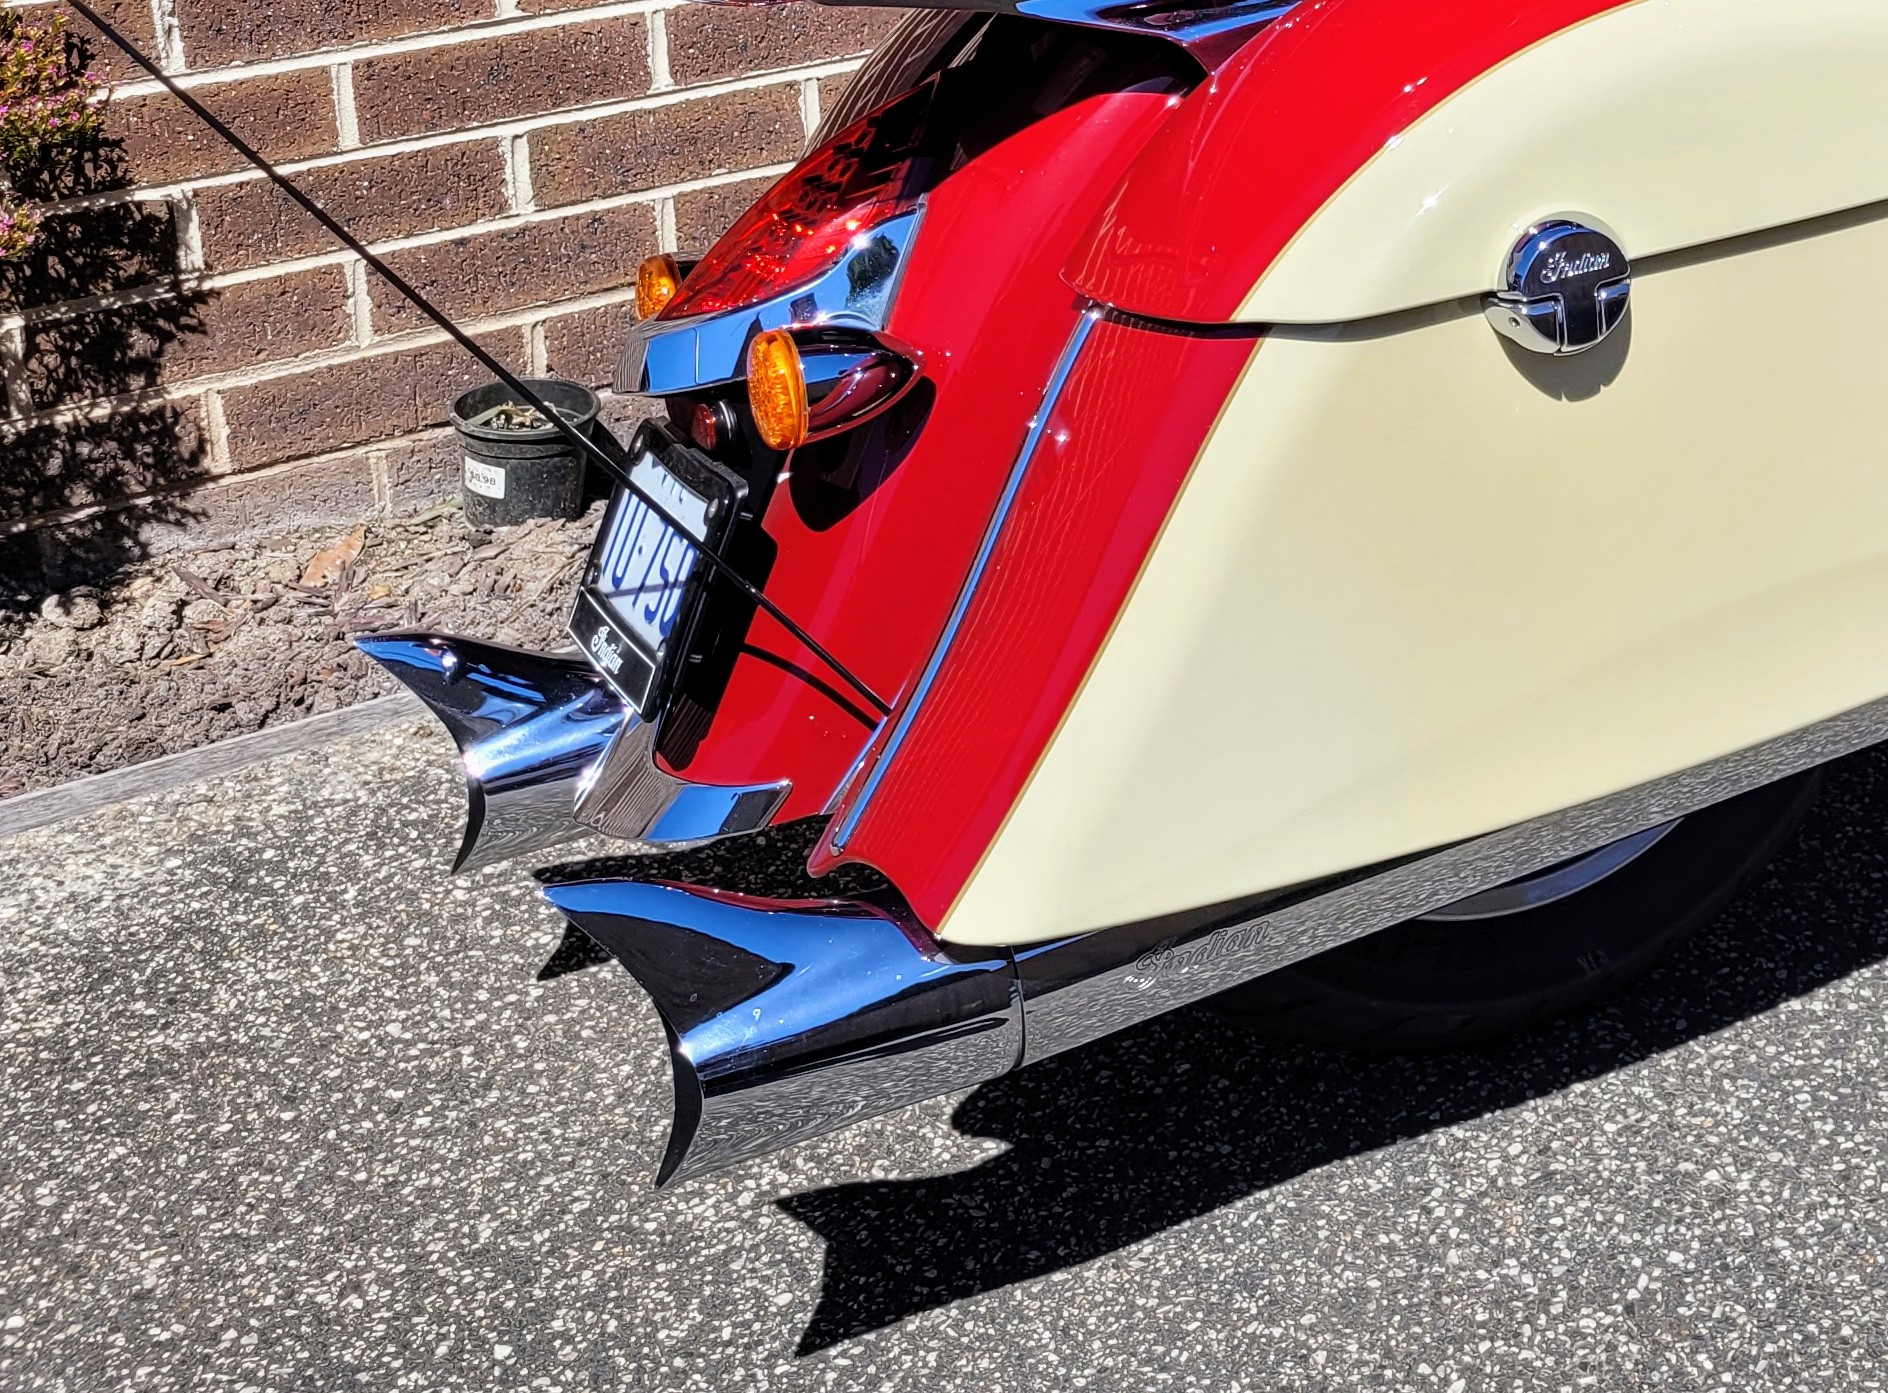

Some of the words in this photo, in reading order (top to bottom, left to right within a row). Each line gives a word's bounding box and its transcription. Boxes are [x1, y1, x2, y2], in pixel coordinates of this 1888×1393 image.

[1540, 251, 1610, 284] Indian
[591, 625, 624, 675] Indian
[1123, 920, 1270, 991] Indian
